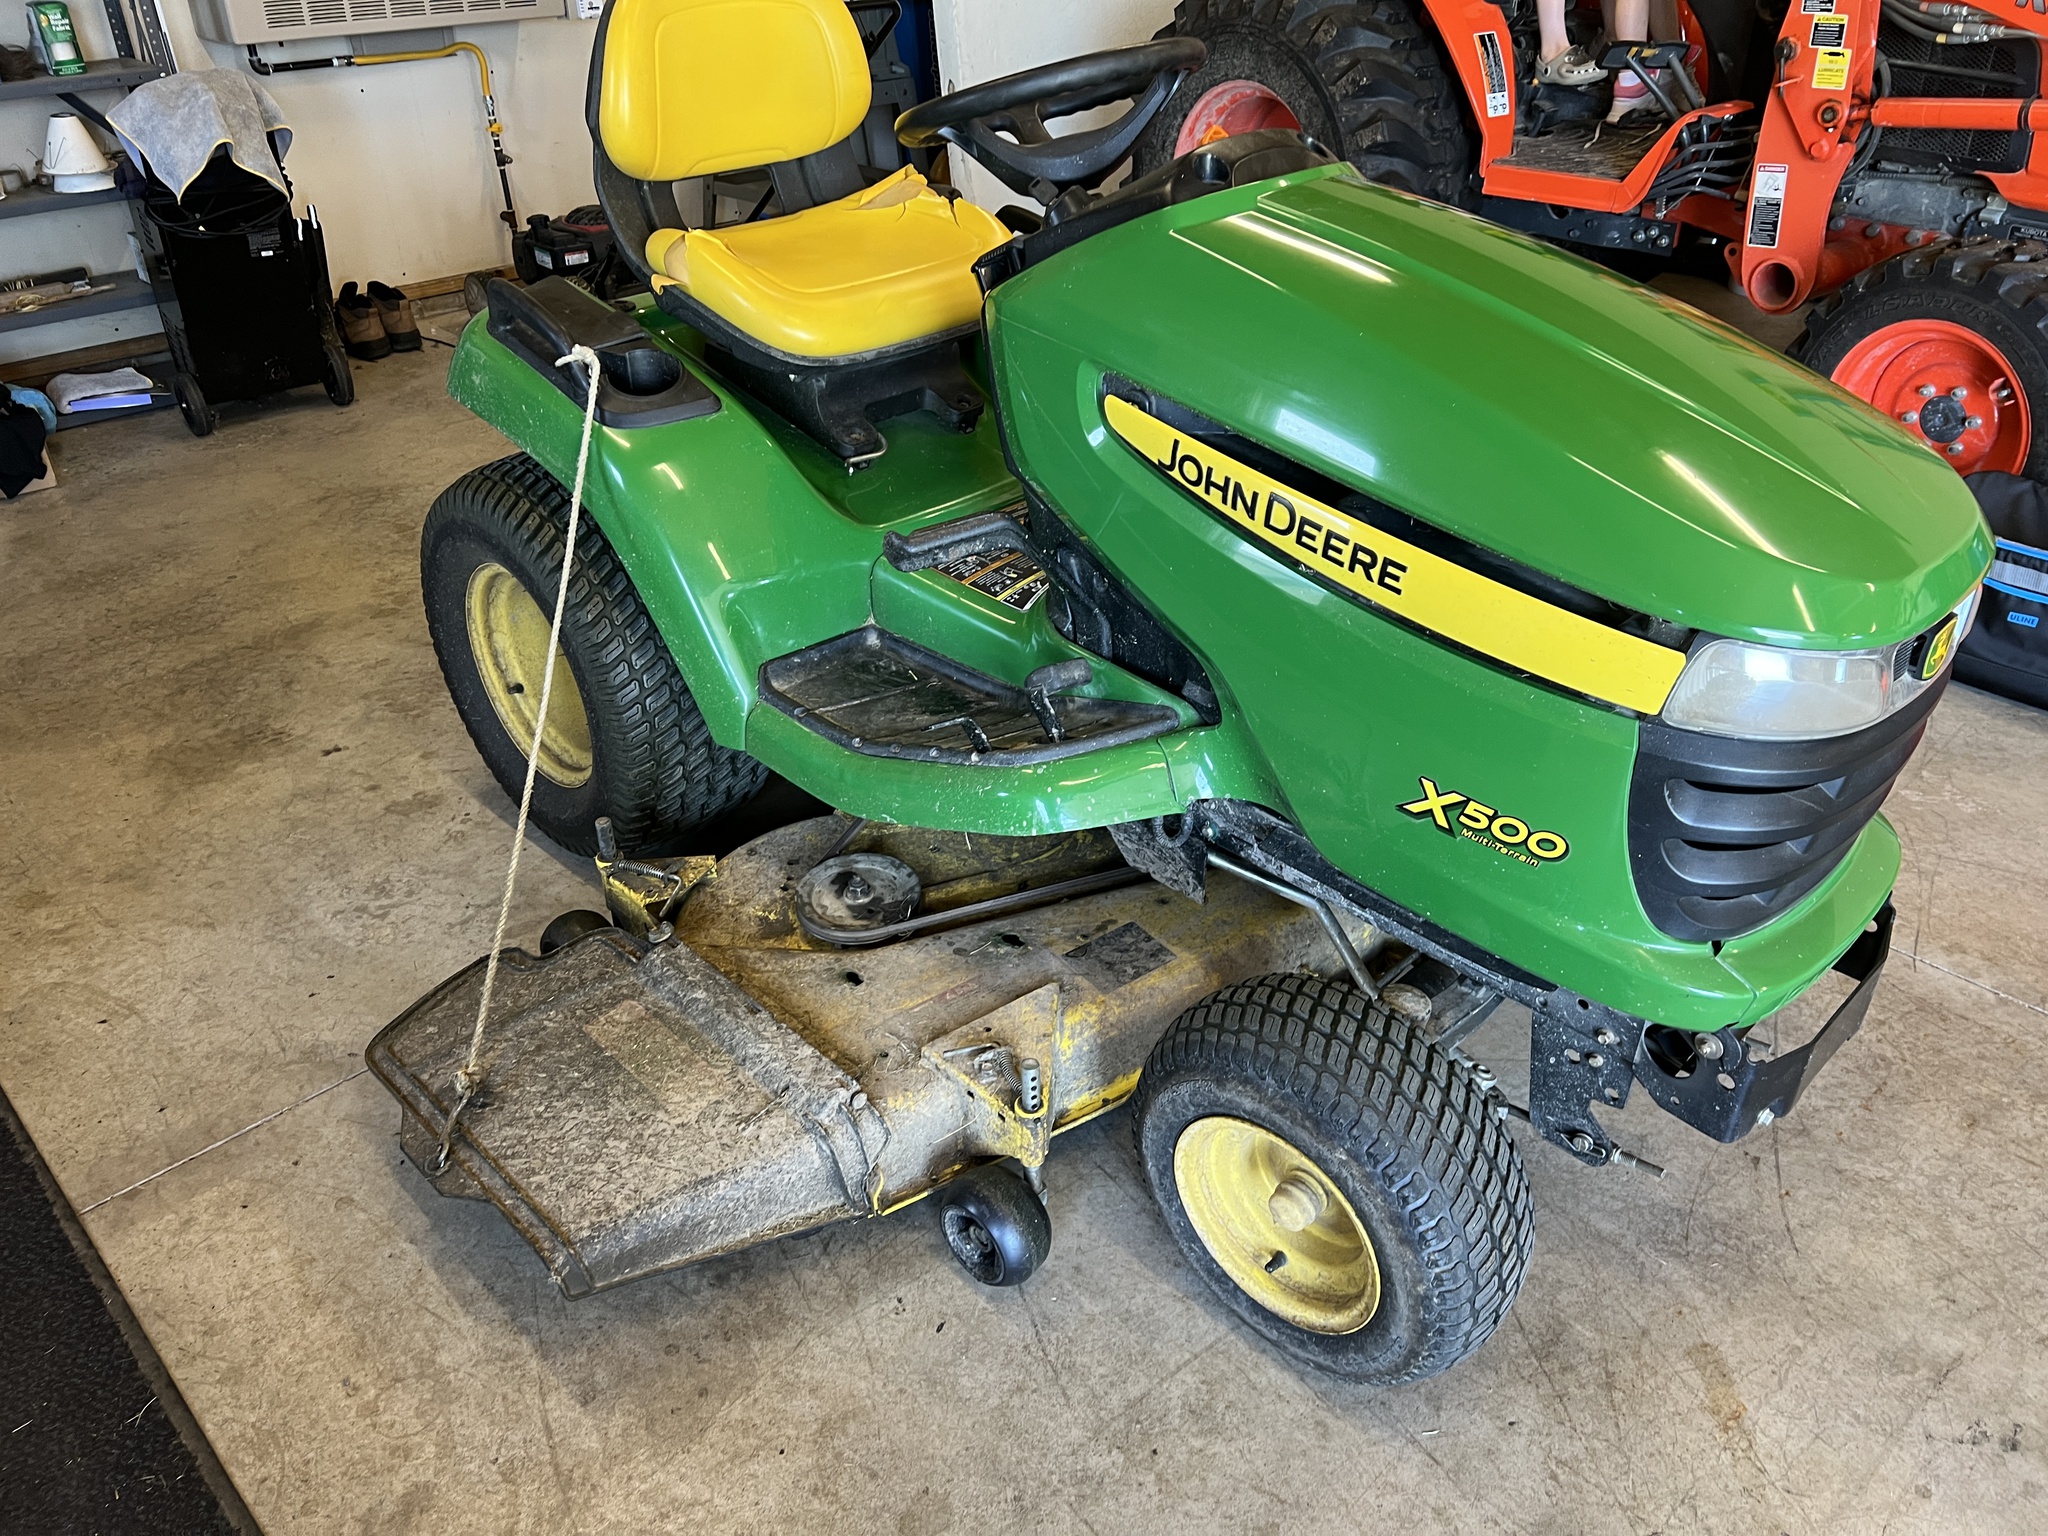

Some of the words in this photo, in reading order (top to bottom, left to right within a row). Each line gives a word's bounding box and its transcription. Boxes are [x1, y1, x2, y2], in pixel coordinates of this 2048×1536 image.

[2020, 227, 2047, 237] KUBOTA
[1865, 293, 1992, 323] LOADER
[1157, 438, 1259, 521] JOHN
[1263, 491, 1408, 596] DEERE
[2010, 613, 2037, 626] ULINE
[1397, 776, 1569, 861] X500
[1460, 828, 1540, 868] Multi-Terrain
